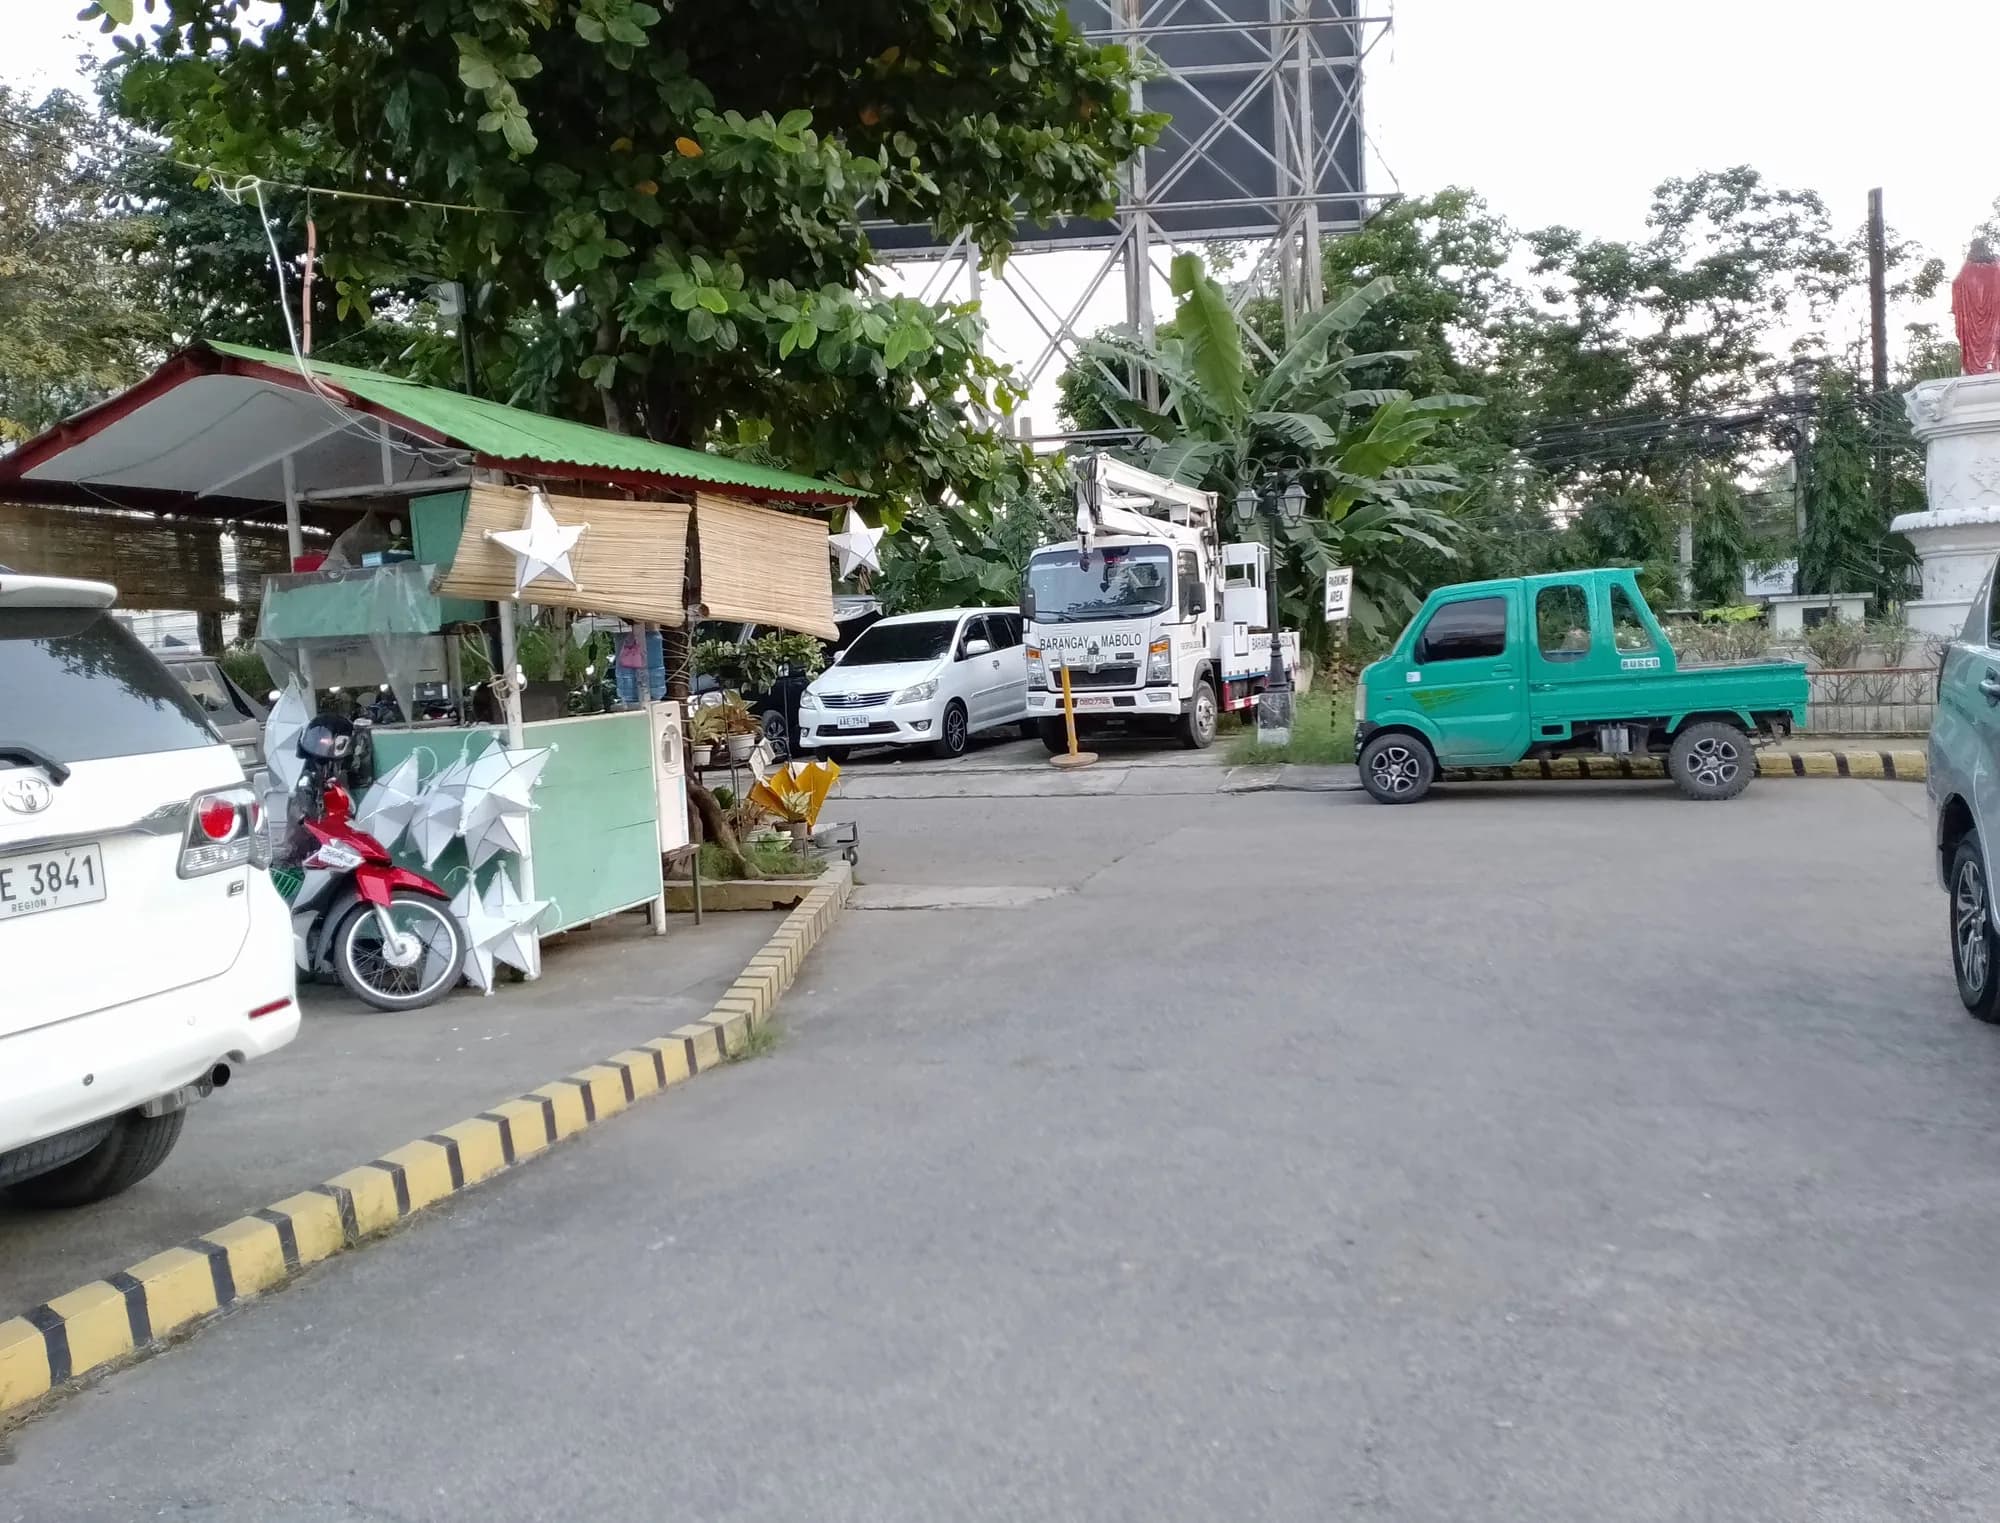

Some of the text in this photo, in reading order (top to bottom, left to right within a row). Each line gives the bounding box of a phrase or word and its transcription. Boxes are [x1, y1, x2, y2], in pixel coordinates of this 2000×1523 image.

[1040, 633, 1142, 651] BARANGAY MABOLO
[28, 854, 94, 895] 3841
[11, 896, 58, 913] REGION 7
